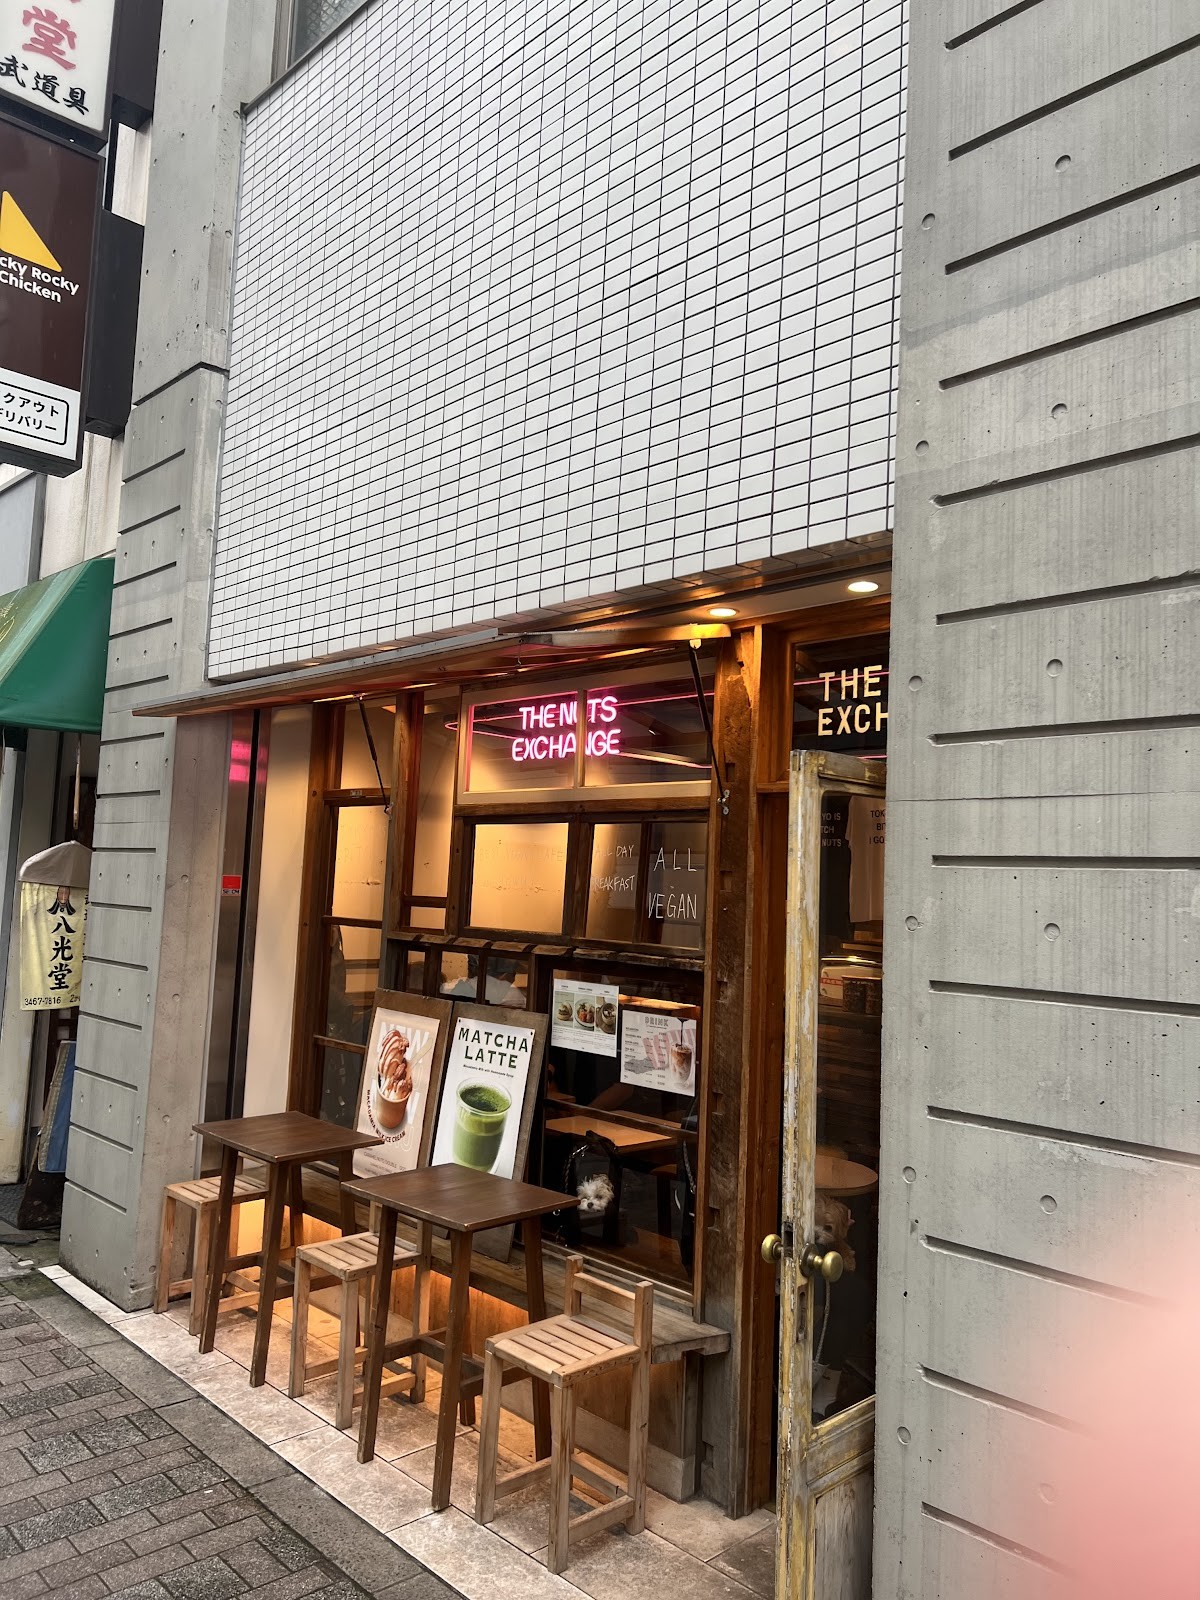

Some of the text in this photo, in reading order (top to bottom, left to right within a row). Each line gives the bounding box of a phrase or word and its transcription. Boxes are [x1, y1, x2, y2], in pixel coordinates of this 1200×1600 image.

[0, 54, 89, 115] 武道具
[0, 270, 62, 303] Chicken
[31, 266, 80, 296] Rocky
[3, 392, 59, 417] クアウト
[819, 664, 882, 702] THE
[518, 703, 556, 730] THE
[614, 844, 634, 858] DAY
[652, 846, 697, 872] ALL
[647, 892, 697, 920] VEGAN
[47, 915, 76, 991] 八光堂
[644, 1015, 669, 1028] DRINK
[458, 1027, 528, 1053] MATCHA
[464, 1045, 518, 1069] LATTE
